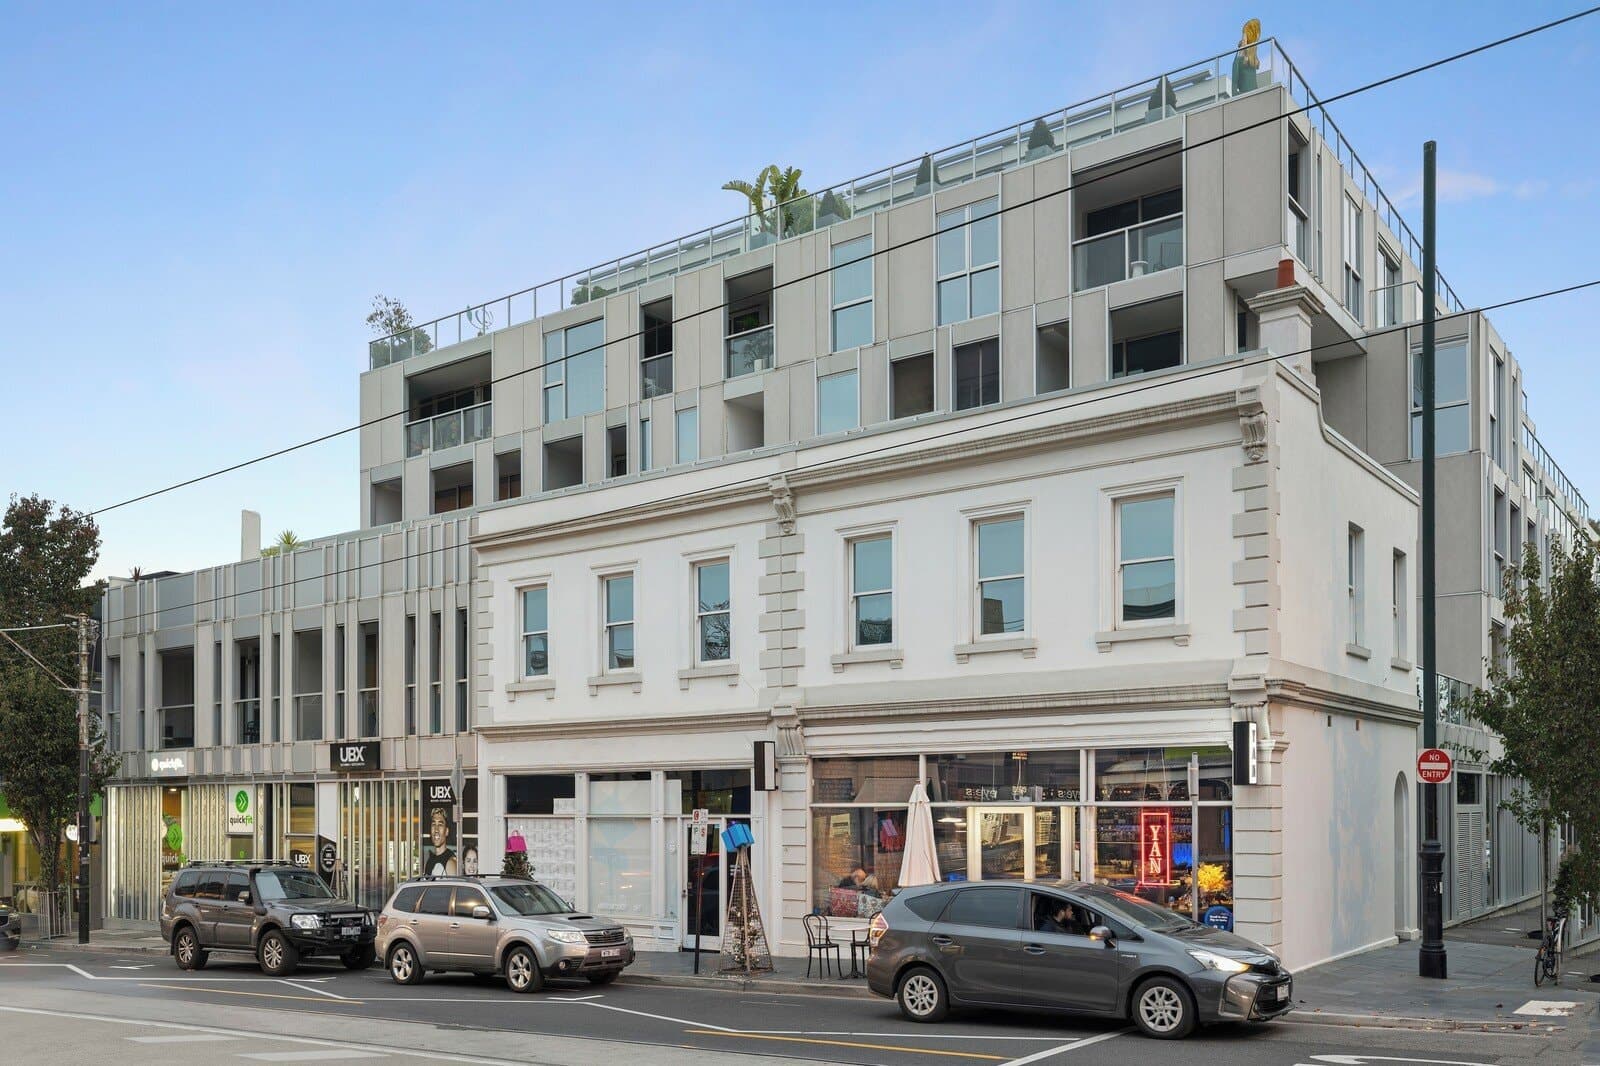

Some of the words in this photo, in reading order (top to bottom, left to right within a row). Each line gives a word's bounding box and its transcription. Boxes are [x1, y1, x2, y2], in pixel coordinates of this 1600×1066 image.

[340, 746, 365, 762] UBX
[1429, 753, 1440, 761] NO
[1422, 770, 1446, 778] ENTRY
[430, 786, 451, 799] UBX
[229, 815, 253, 827] quickfit
[1149, 825, 1162, 874] YAN
[295, 854, 312, 864] UBX
